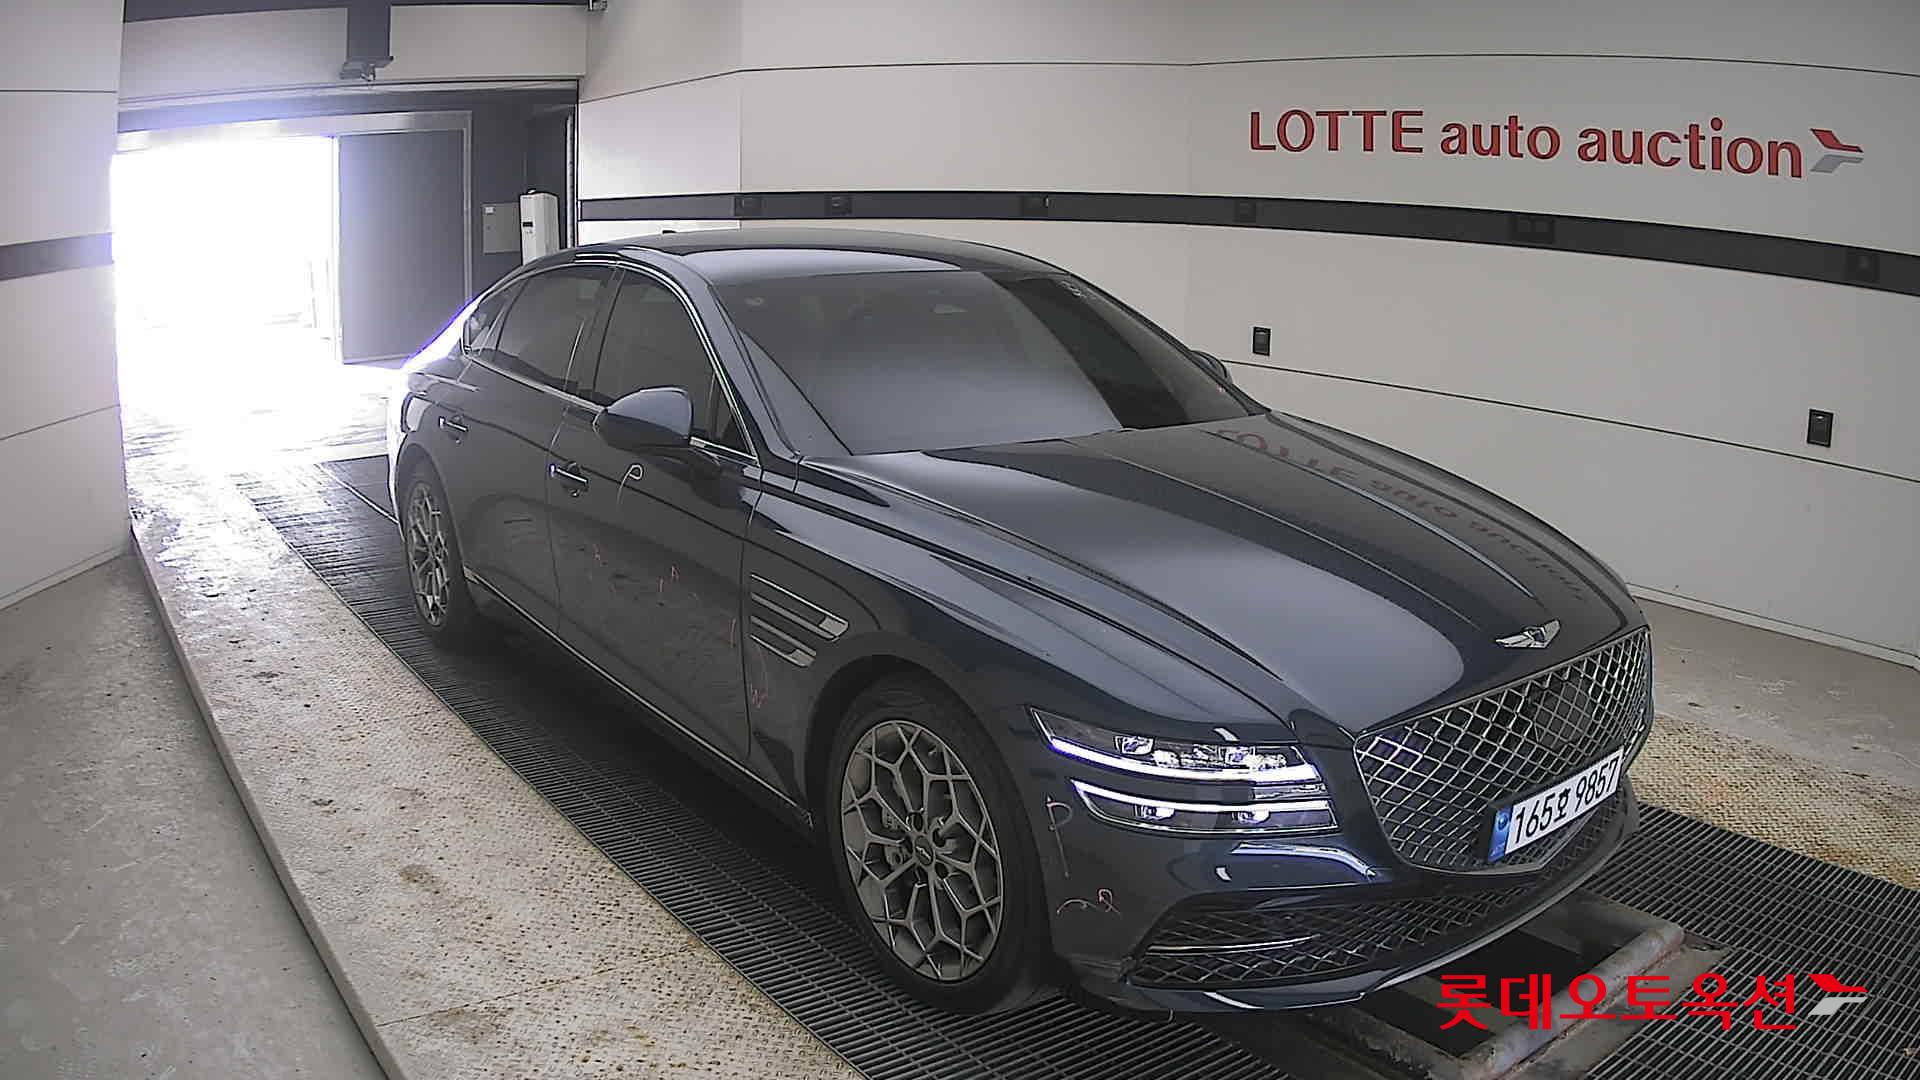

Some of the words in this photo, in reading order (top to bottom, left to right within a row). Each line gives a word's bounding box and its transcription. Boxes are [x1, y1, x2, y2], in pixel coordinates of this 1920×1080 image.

[1250, 111, 1424, 153] LOTTE
[1440, 116, 1561, 159] auto
[1577, 118, 1804, 178] auction
[1514, 788, 1572, 844] 165호
[1575, 755, 1621, 813] 9857
